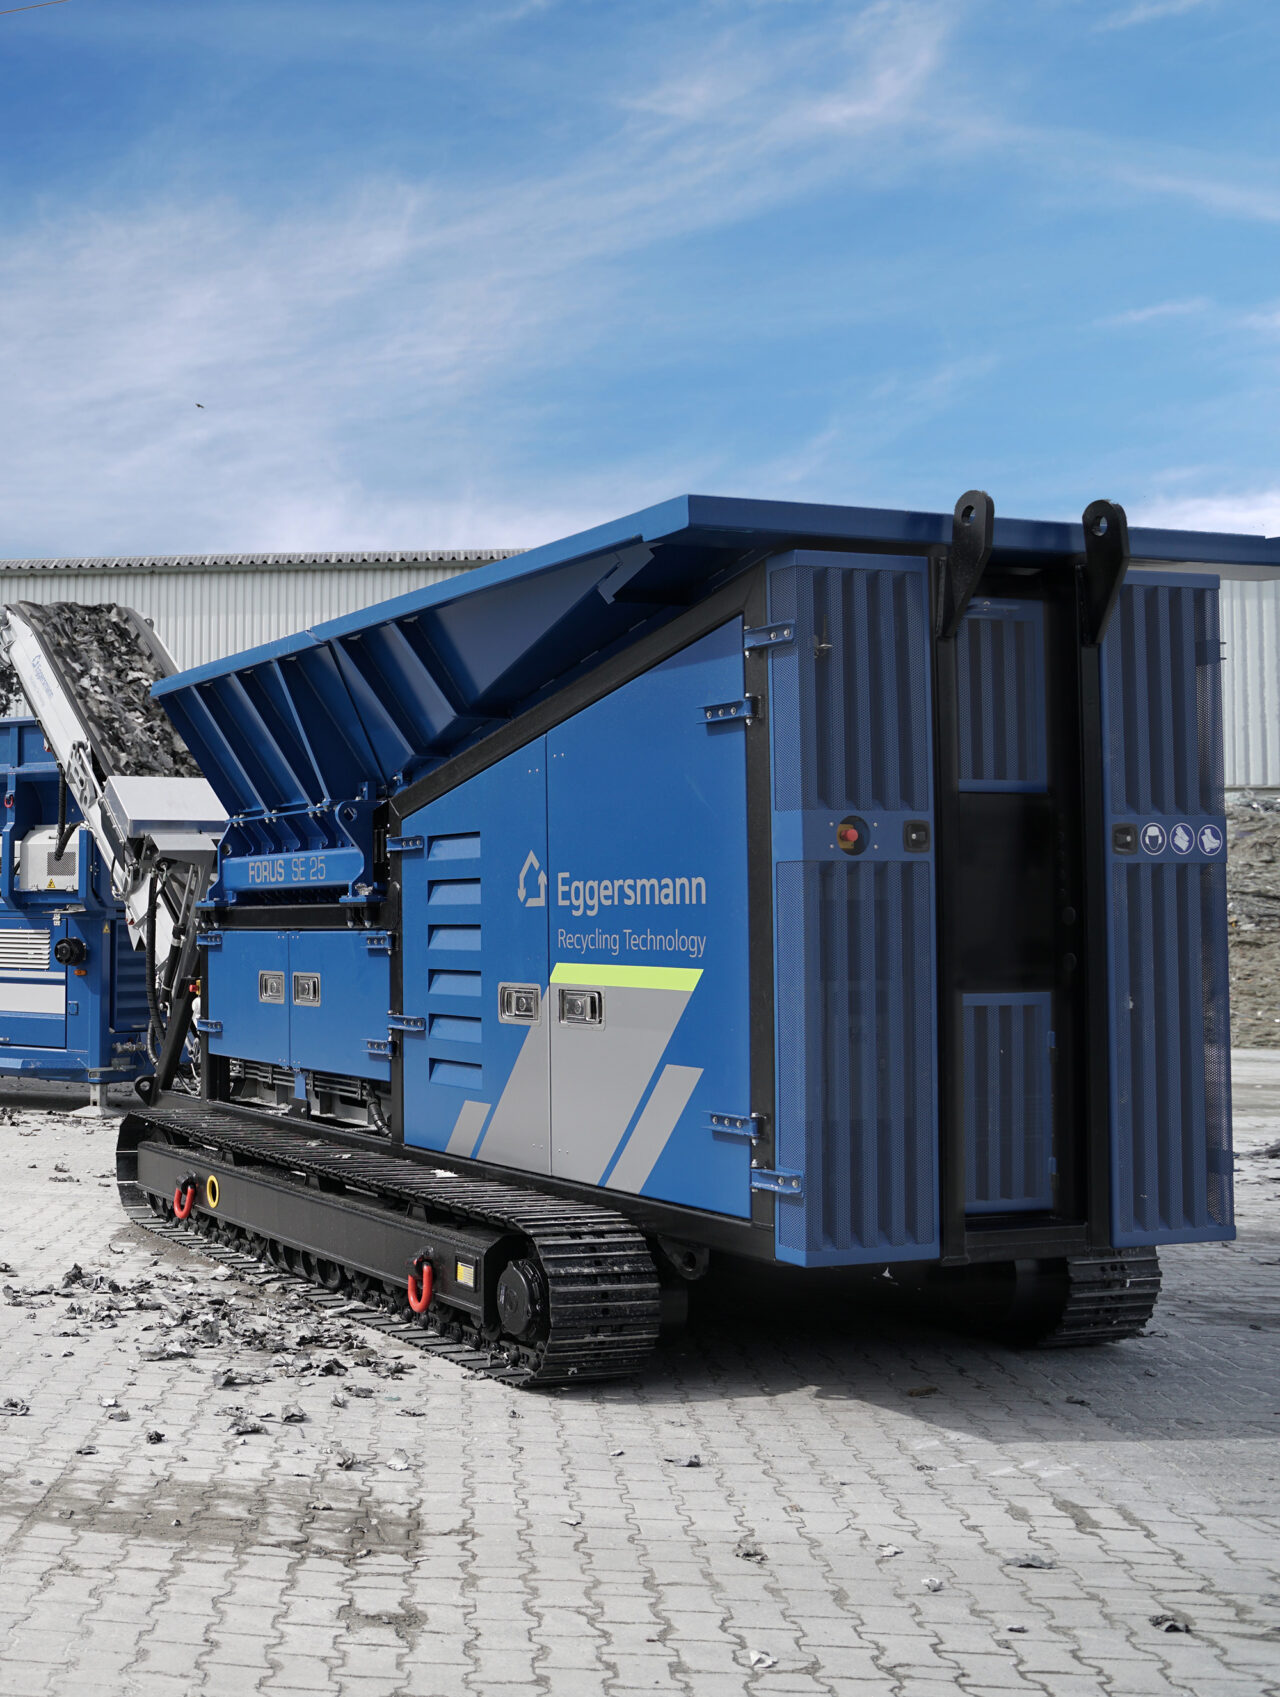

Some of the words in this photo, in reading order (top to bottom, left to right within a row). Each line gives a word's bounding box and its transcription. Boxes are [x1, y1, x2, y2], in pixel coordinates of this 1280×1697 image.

[248, 859, 285, 884] FORUS
[291, 857, 306, 881] SE
[309, 855, 326, 880] 25
[557, 871, 707, 917] Eggersmann
[558, 927, 620, 956] Recycling
[623, 928, 707, 958] Technology
